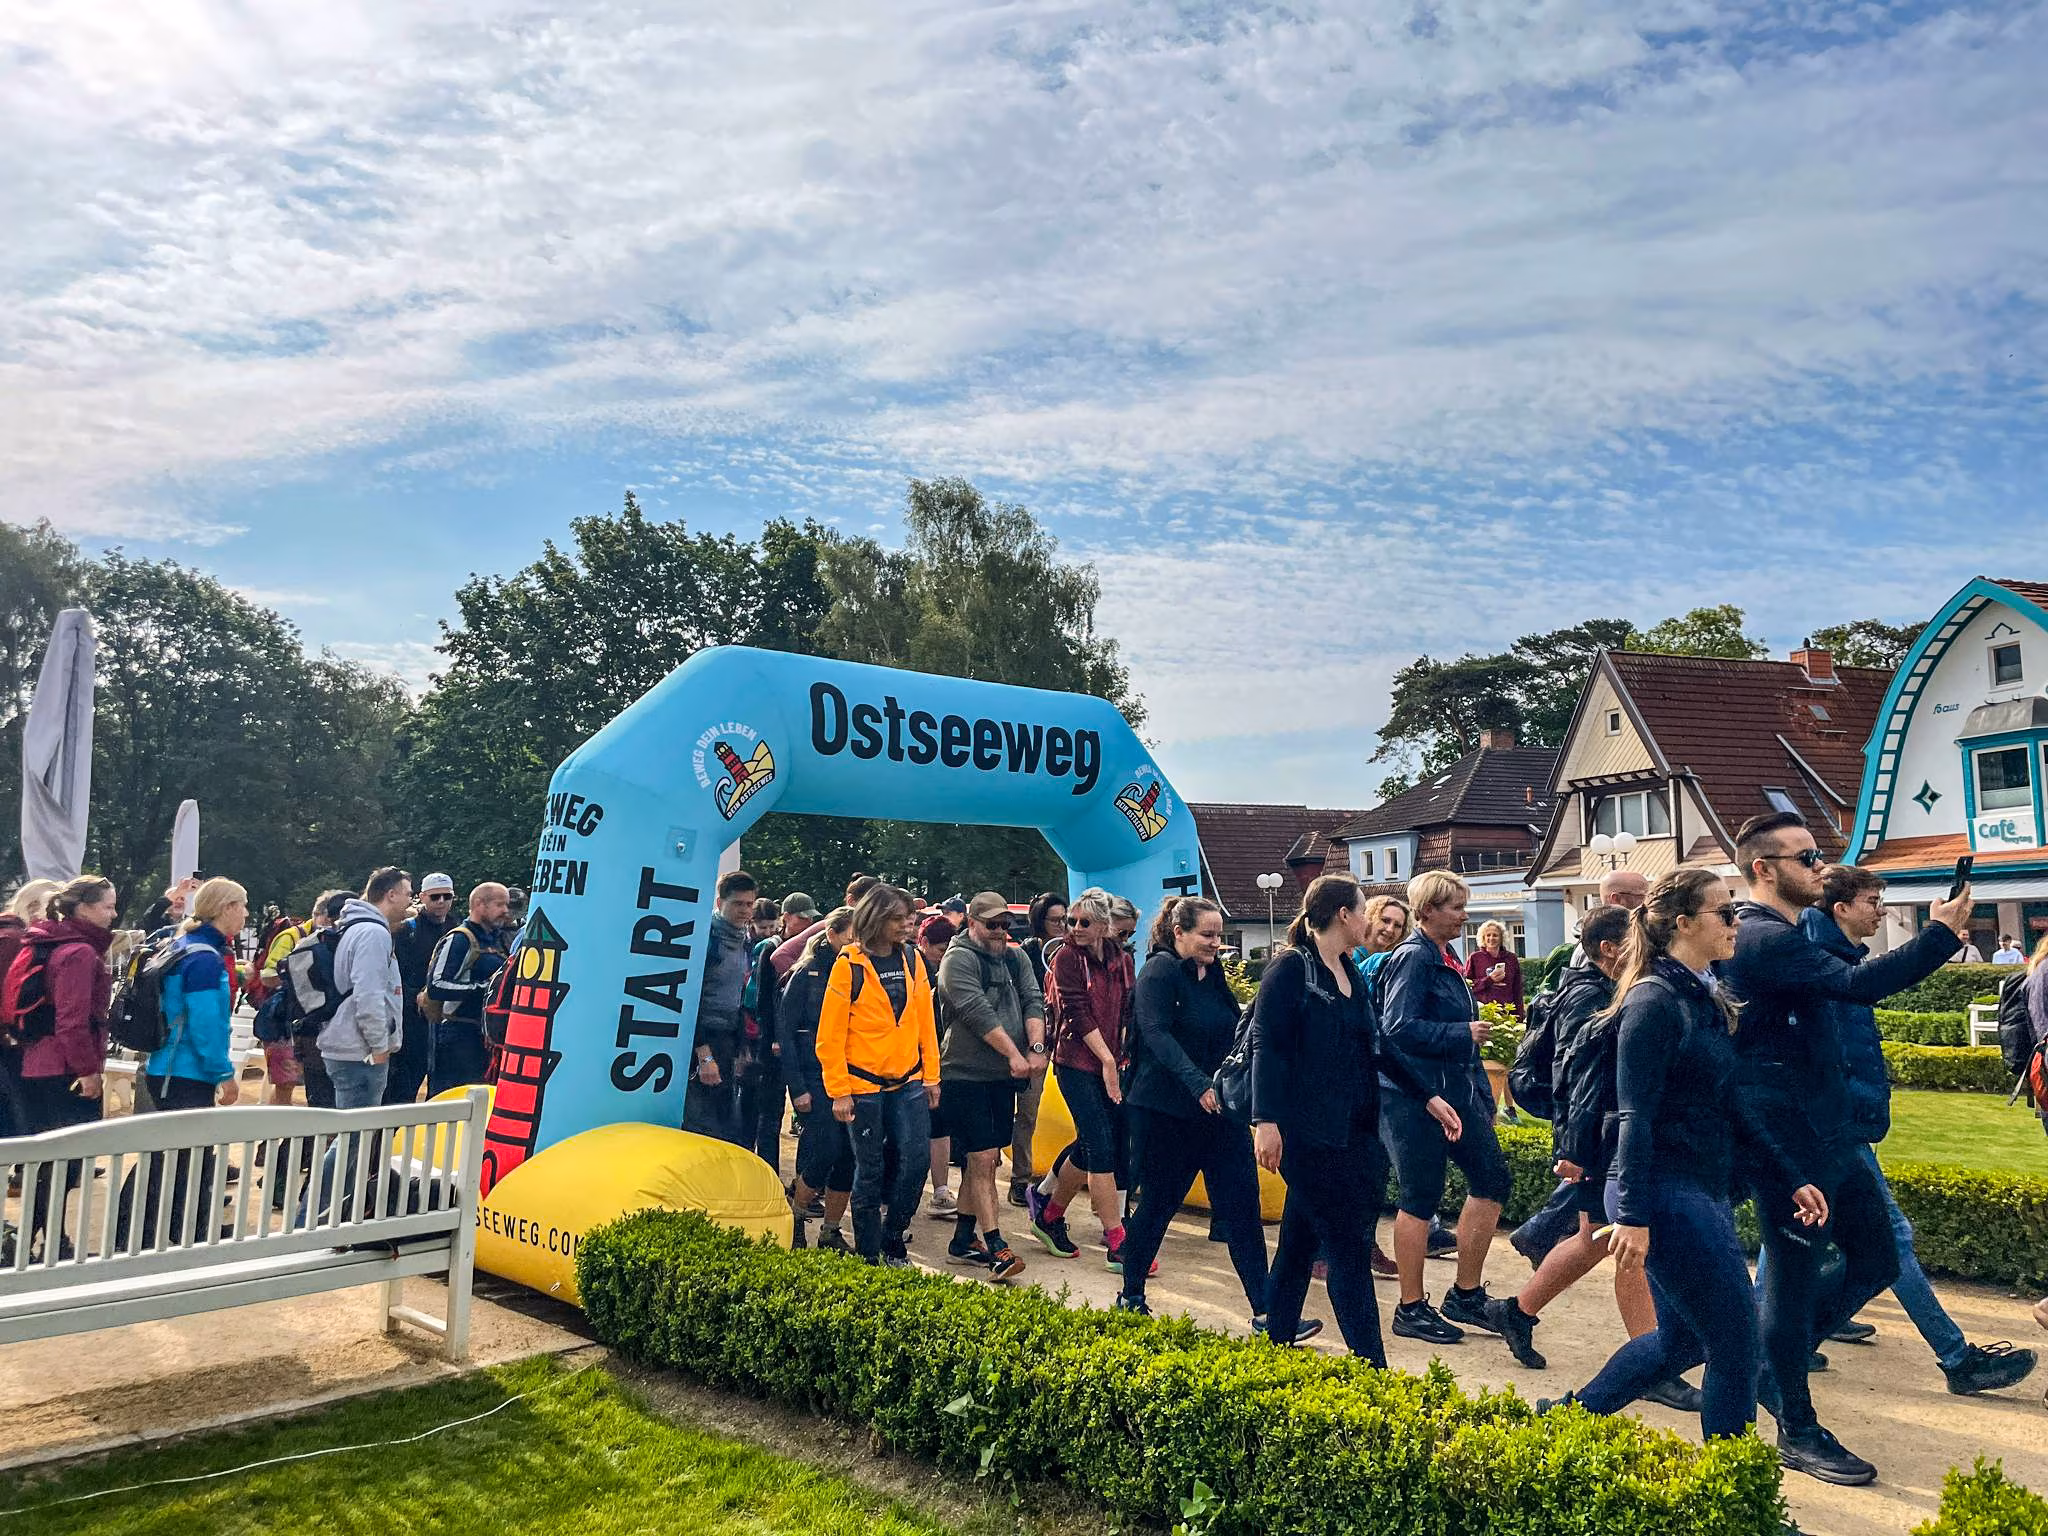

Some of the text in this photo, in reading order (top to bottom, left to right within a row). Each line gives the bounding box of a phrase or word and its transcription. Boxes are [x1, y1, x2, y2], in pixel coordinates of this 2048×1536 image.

[692, 722, 757, 789] BEWEG DEIN LEBEN
[809, 682, 1101, 796] Ostseeweg
[726, 773, 773, 818] DEIN OSTSEEWEG
[541, 834, 567, 852] DEIN
[1979, 819, 2016, 841] Café
[610, 866, 700, 1093] START
